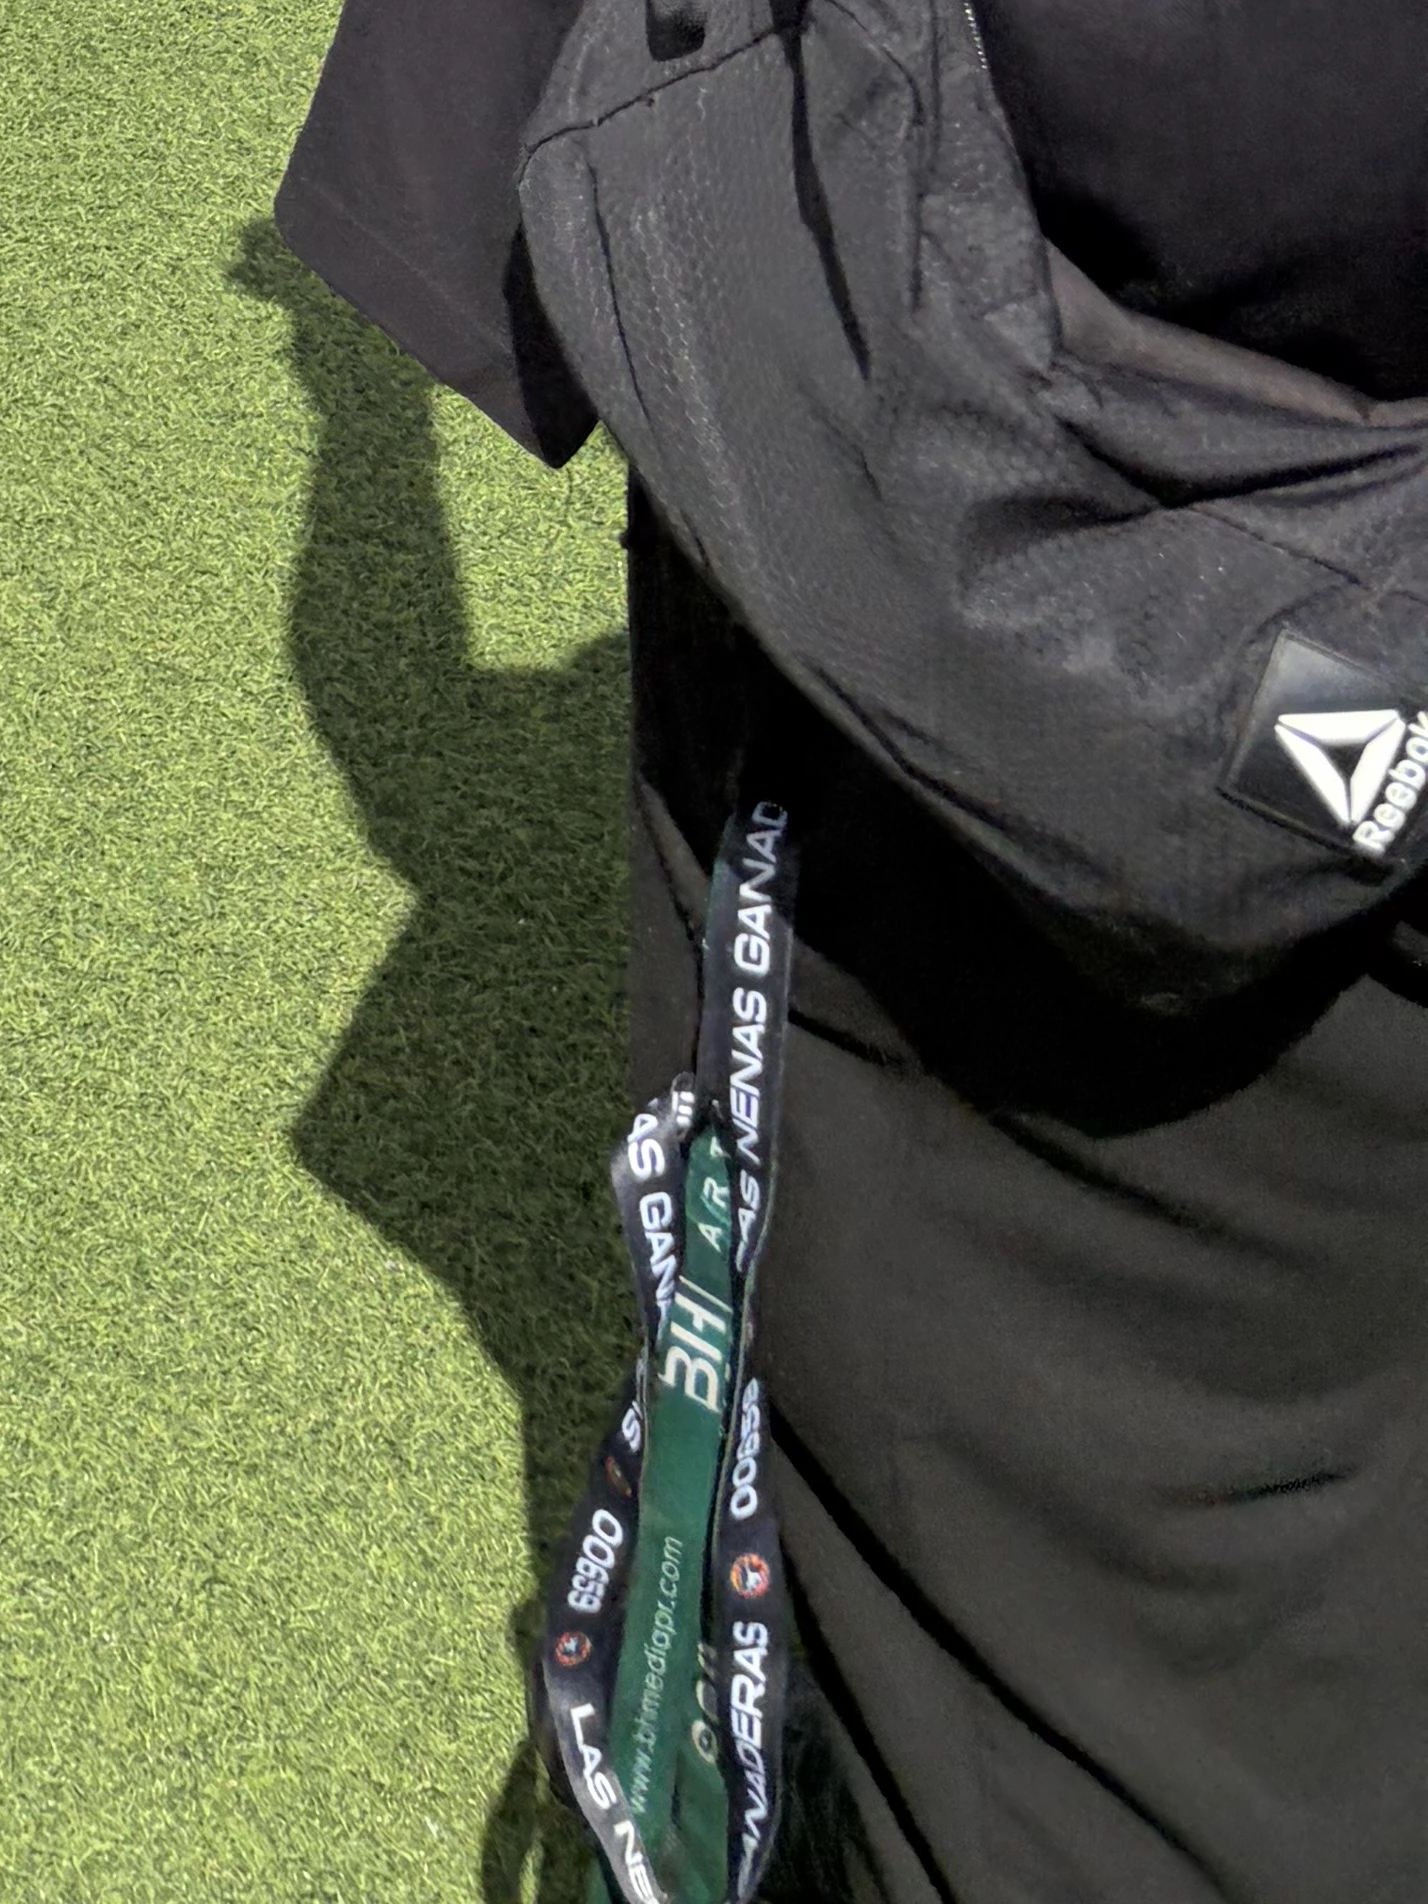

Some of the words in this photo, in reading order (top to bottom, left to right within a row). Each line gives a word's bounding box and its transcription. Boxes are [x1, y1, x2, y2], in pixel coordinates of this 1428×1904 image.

[734, 800, 788, 976] GANAD
[730, 987, 768, 1166] NENAS
[570, 1703, 618, 1811] LAS
